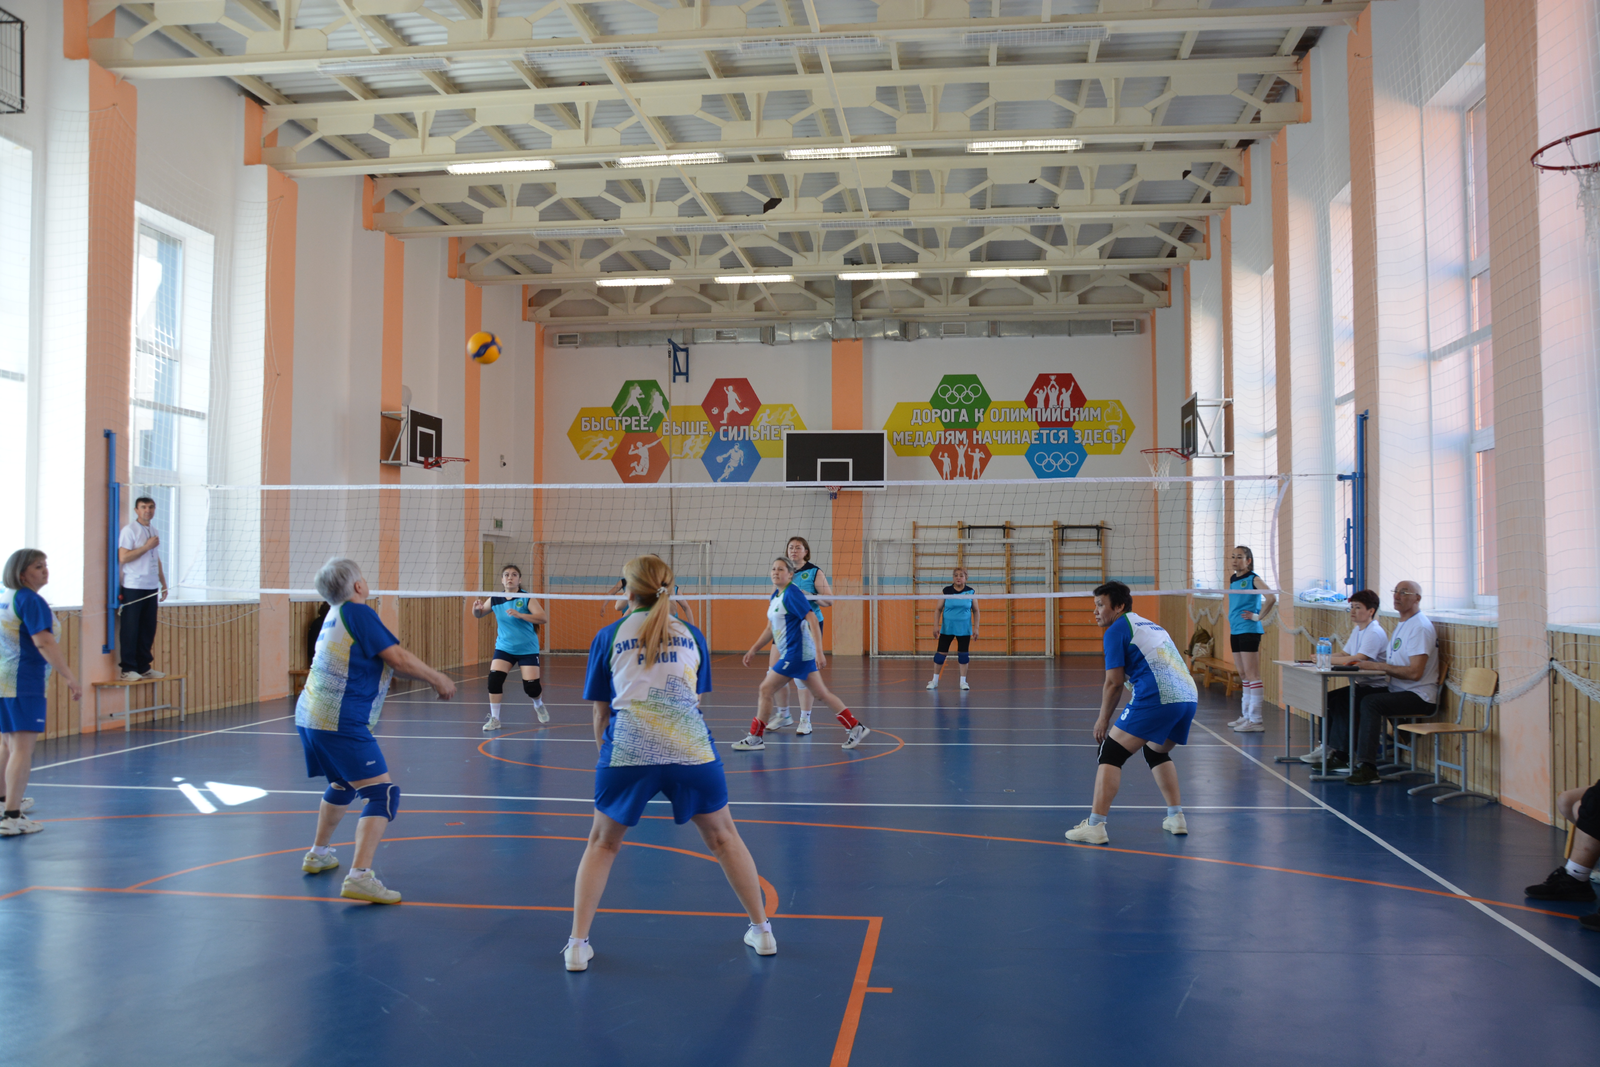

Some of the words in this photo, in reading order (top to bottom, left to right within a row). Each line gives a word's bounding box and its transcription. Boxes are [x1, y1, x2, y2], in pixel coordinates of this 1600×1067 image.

[910, 408, 969, 425] ДОРОГА
[974, 407, 985, 423] К
[989, 404, 1102, 423] ОЛИМПИЙСКИМ
[581, 416, 653, 432] БЫСТРЕЕ,
[662, 421, 713, 437] ВЫШЕ,
[892, 430, 967, 447] МЕДАЛЯМ
[972, 429, 1069, 445] НАЧИНАЕТСЯ
[1074, 429, 1127, 446] ЗДЕСЬ!
[615, 636, 695, 654] ЗИЛСКИЙ
[637, 651, 678, 666] РОН
[782, 660, 790, 670] 7
[1120, 707, 1130, 721] 3
